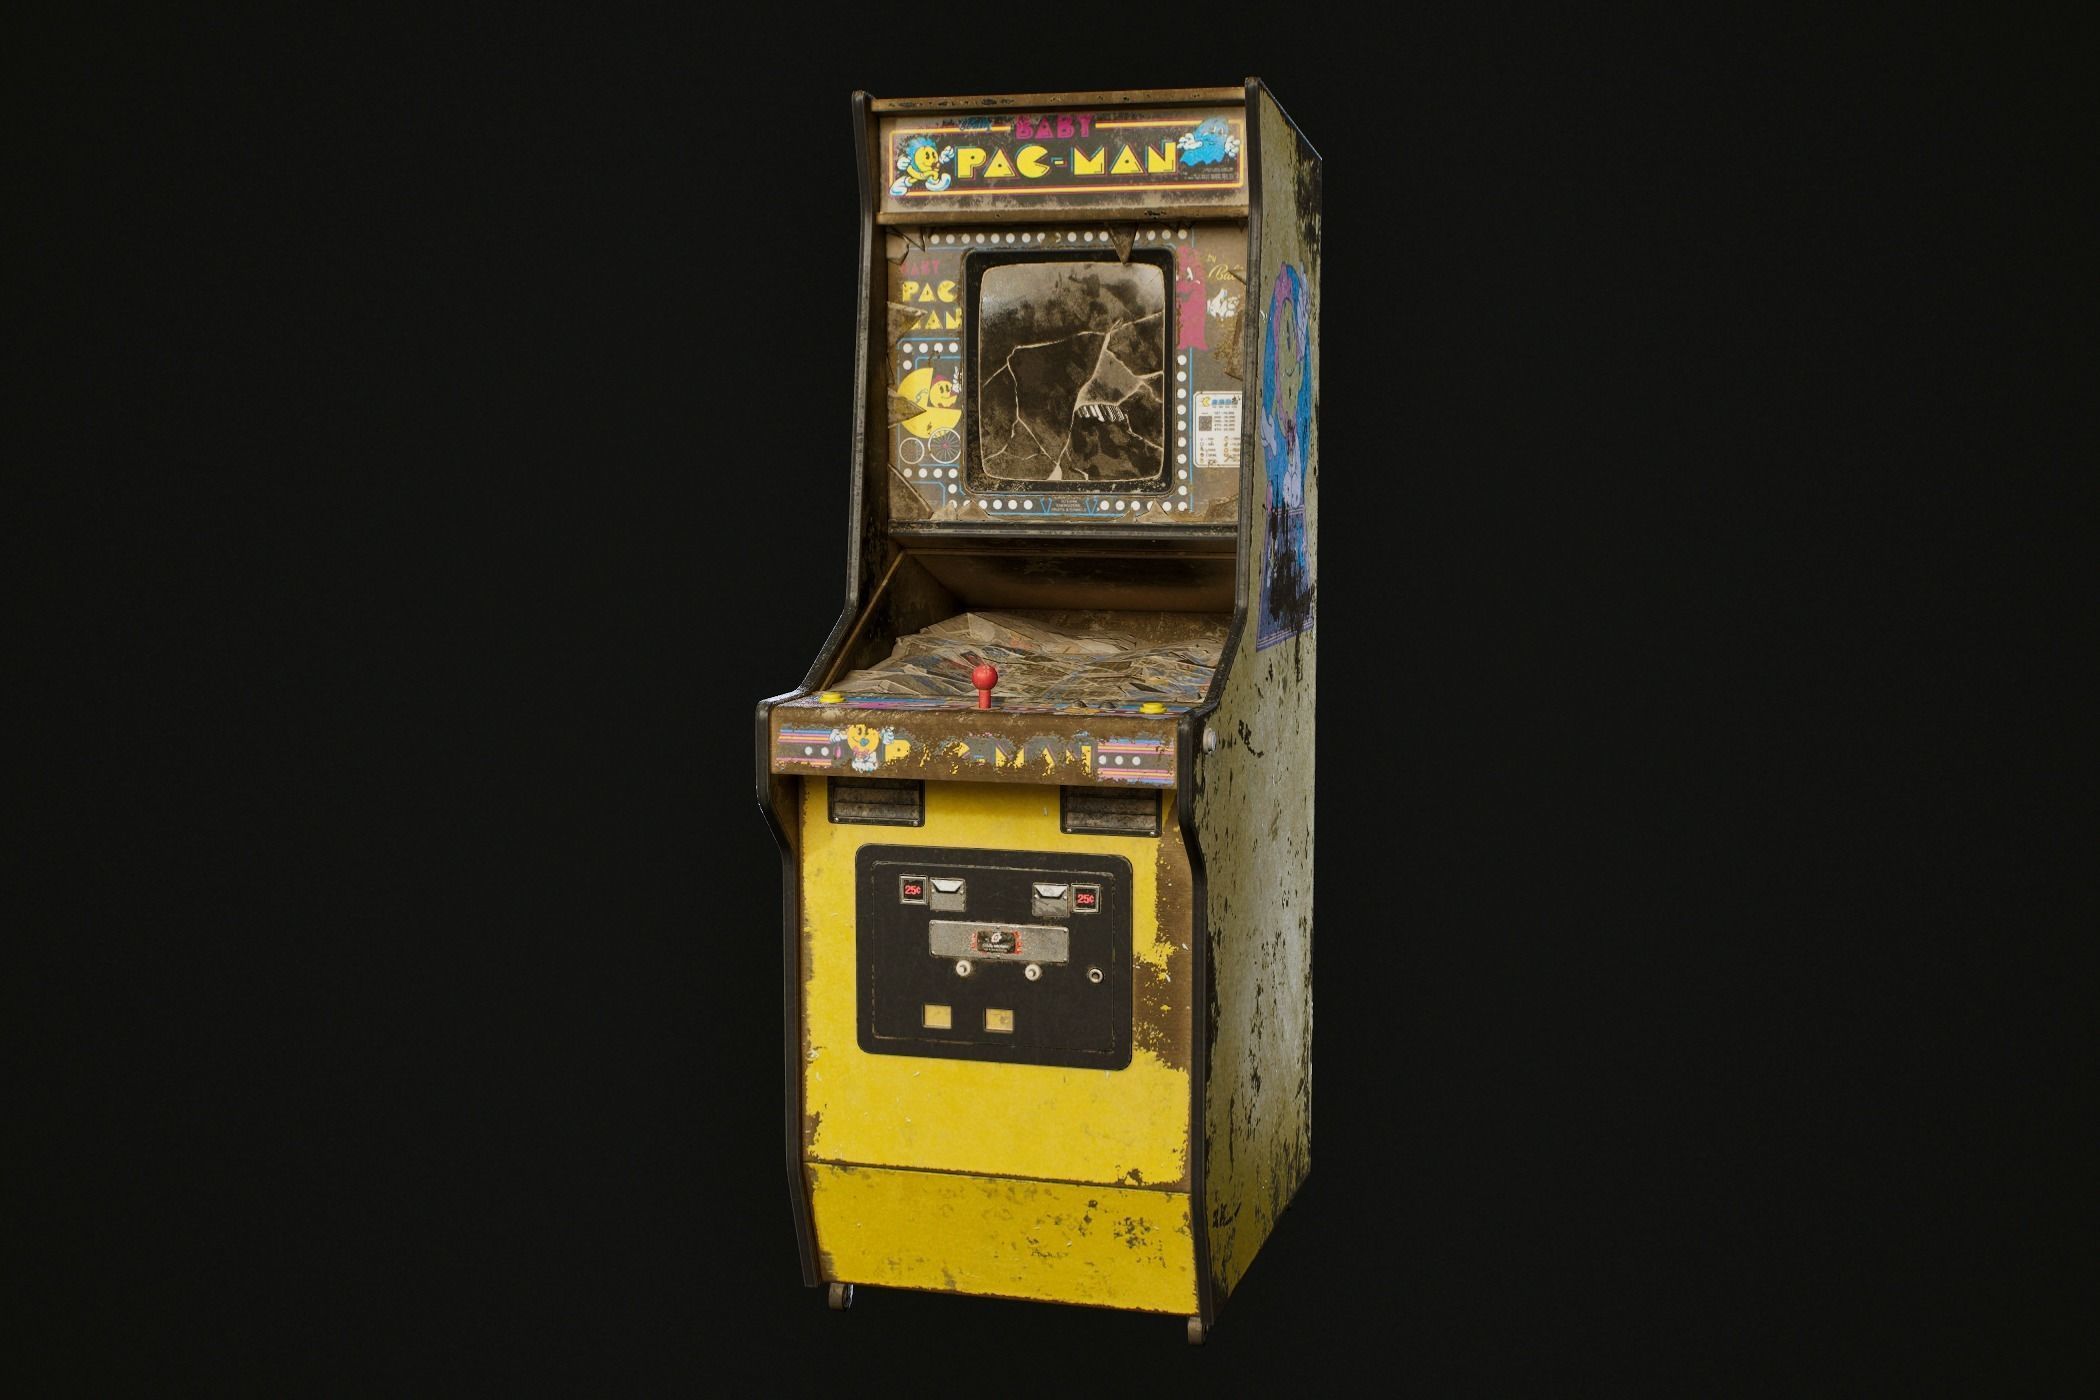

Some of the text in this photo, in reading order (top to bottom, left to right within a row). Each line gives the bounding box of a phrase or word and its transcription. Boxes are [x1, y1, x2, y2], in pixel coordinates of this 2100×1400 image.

[1015, 114, 1092, 139] BABY
[955, 141, 1178, 179] PAC-MAN
[902, 280, 959, 303] PAC
[910, 307, 962, 330] AN
[904, 885, 921, 895] 25¢
[1077, 893, 1095, 904] 25¢
